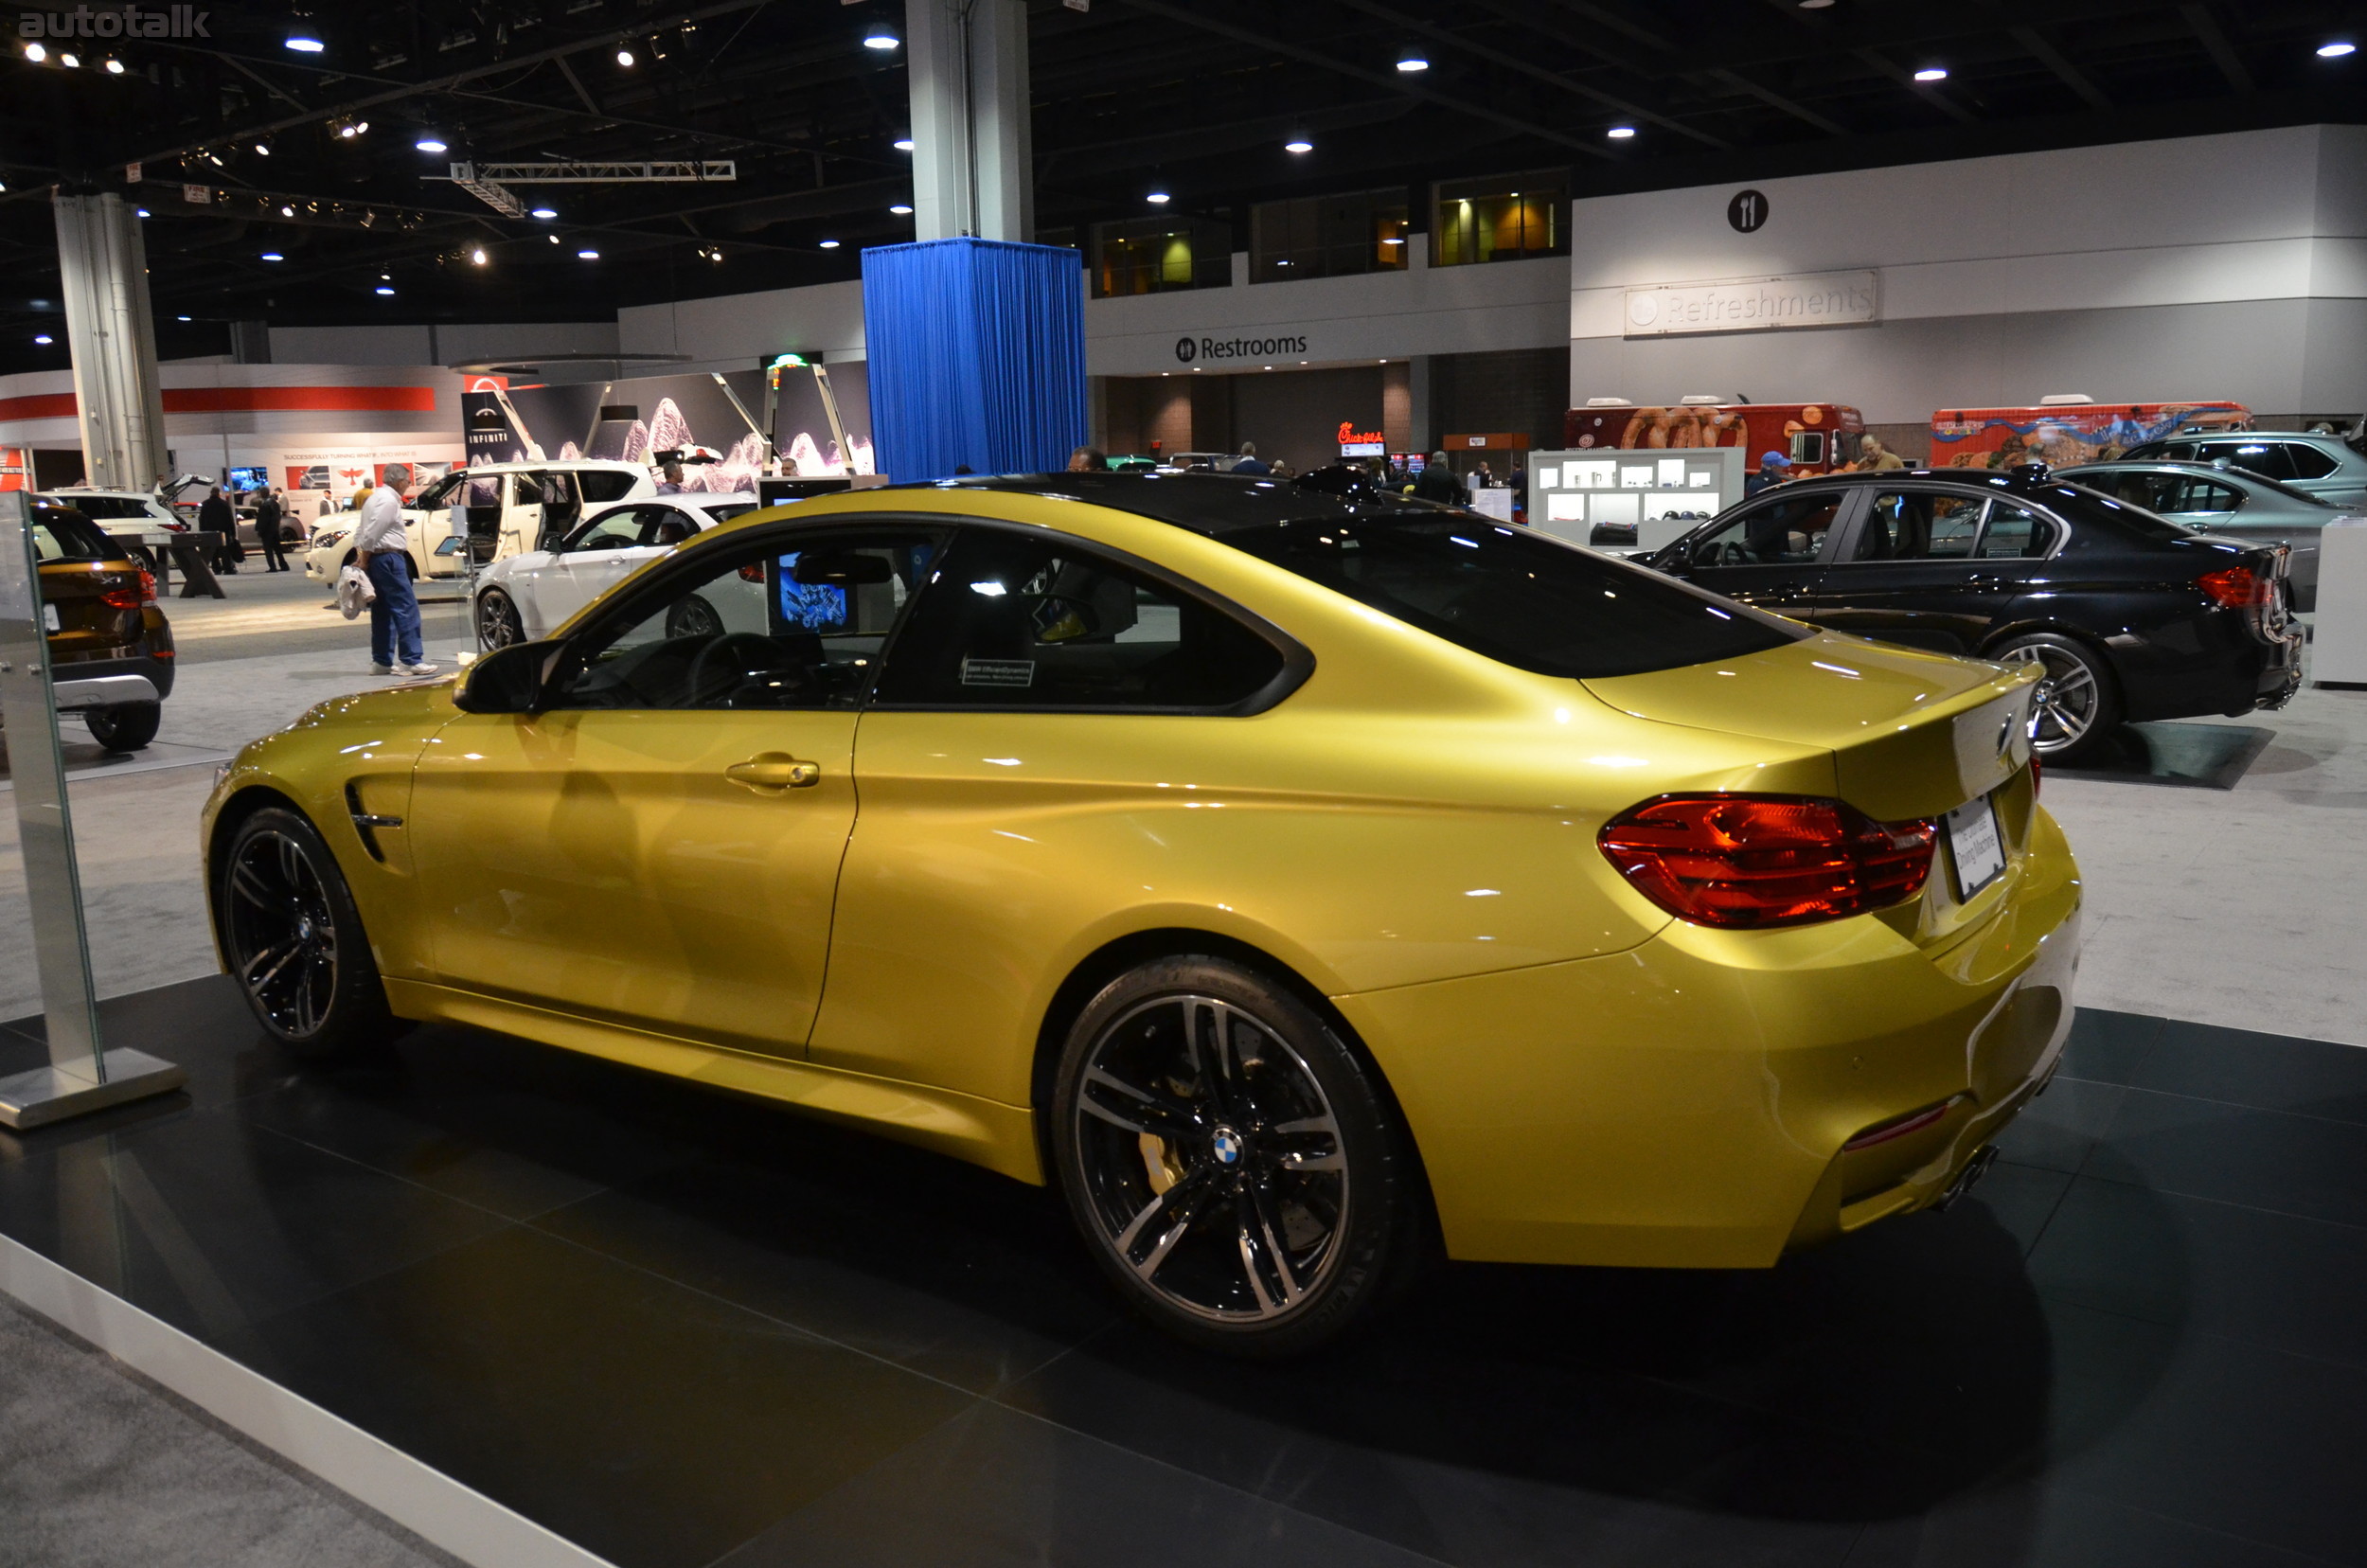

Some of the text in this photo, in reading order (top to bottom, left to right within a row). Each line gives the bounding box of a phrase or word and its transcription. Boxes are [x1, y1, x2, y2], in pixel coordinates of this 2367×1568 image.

[1668, 286, 1872, 323] Refreshments
[1201, 335, 1307, 359] Restrooms
[469, 432, 507, 444] INFINITI
[1956, 833, 1996, 869] Driving Machine
